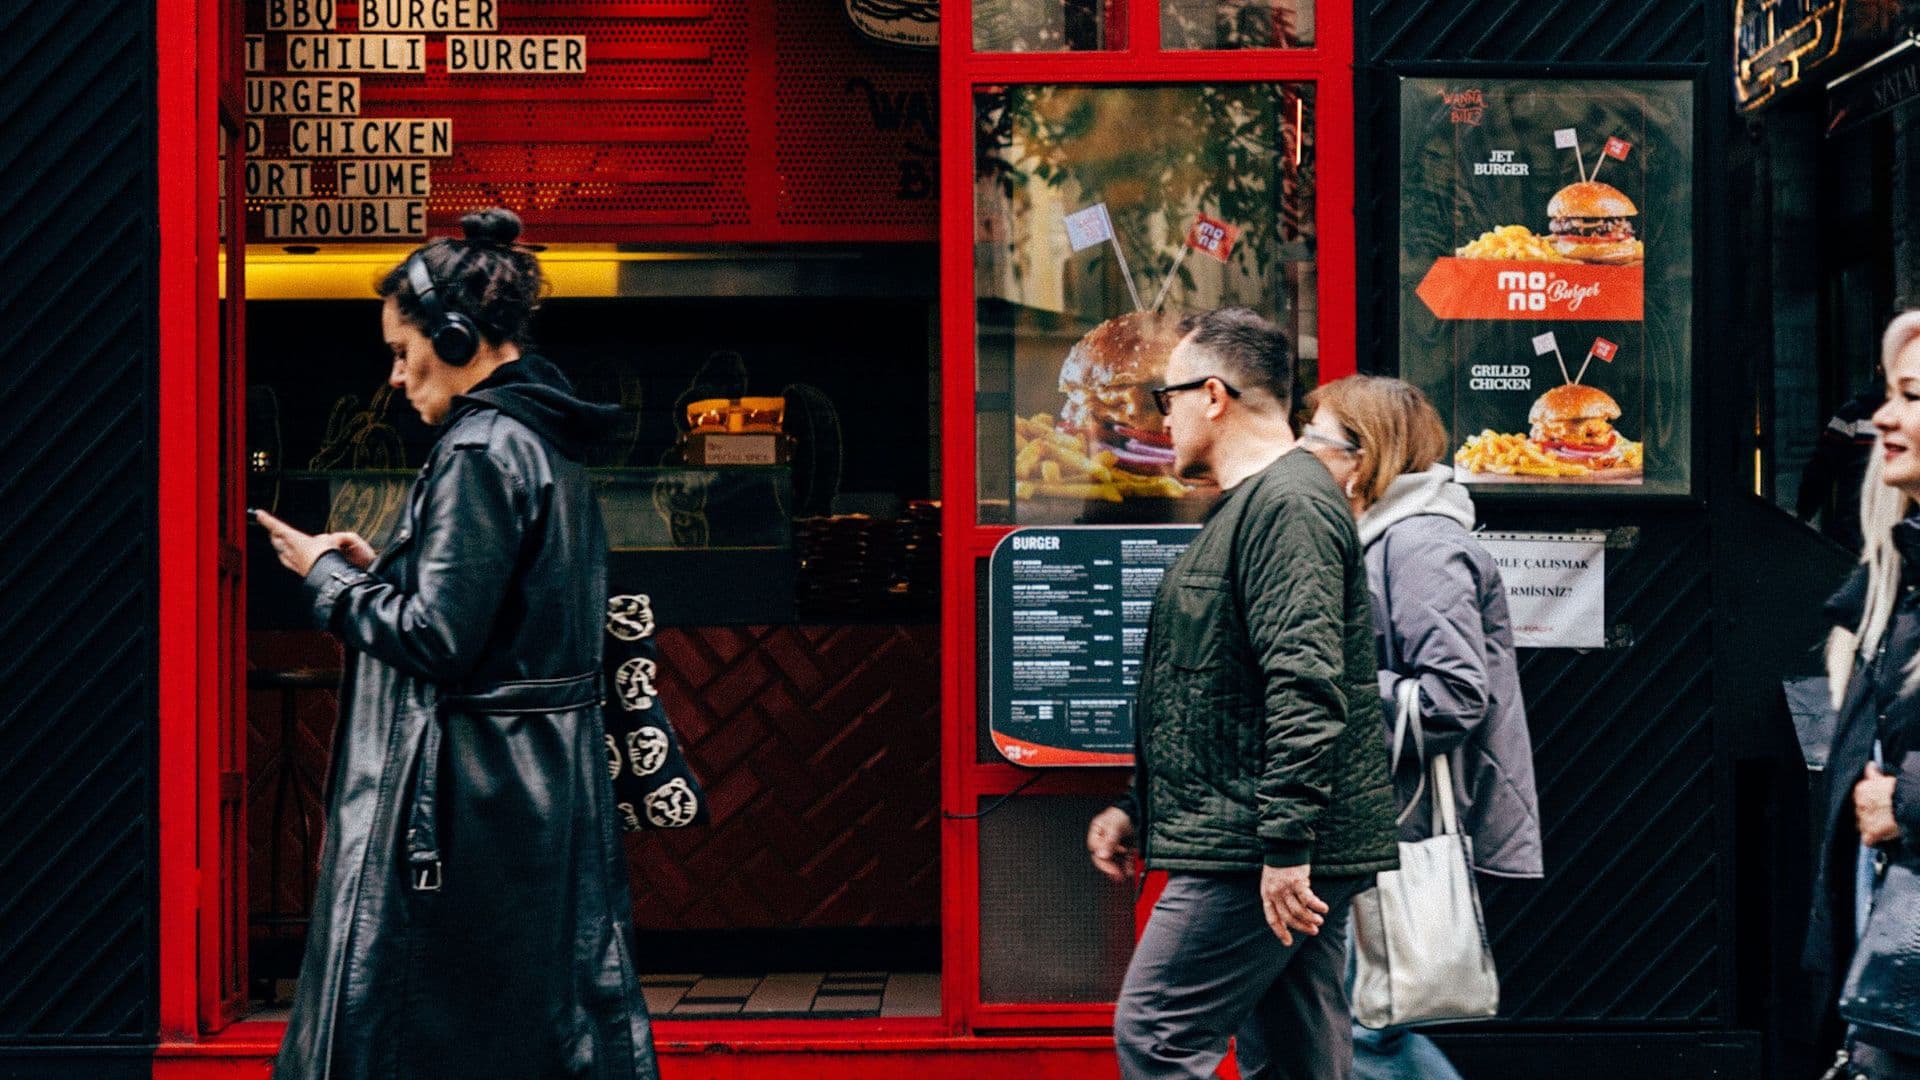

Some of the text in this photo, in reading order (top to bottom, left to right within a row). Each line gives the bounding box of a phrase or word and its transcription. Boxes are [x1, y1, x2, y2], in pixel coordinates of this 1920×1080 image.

[269, 0, 493, 31] BBQ BURGER
[290, 38, 420, 70] CHILLI
[451, 38, 583, 71] BURGER
[248, 80, 356, 112] URGER
[292, 121, 449, 154] CHICKEN
[1474, 163, 1530, 175] BURGER
[1489, 150, 1515, 163] JET
[339, 163, 427, 196] FUME
[266, 204, 424, 236] TROUBLE
[1547, 279, 1600, 312] Burger
[1470, 378, 1531, 390] CHICKEN
[1471, 364, 1530, 377] GRILLED
[1012, 536, 1061, 550] BURGER
